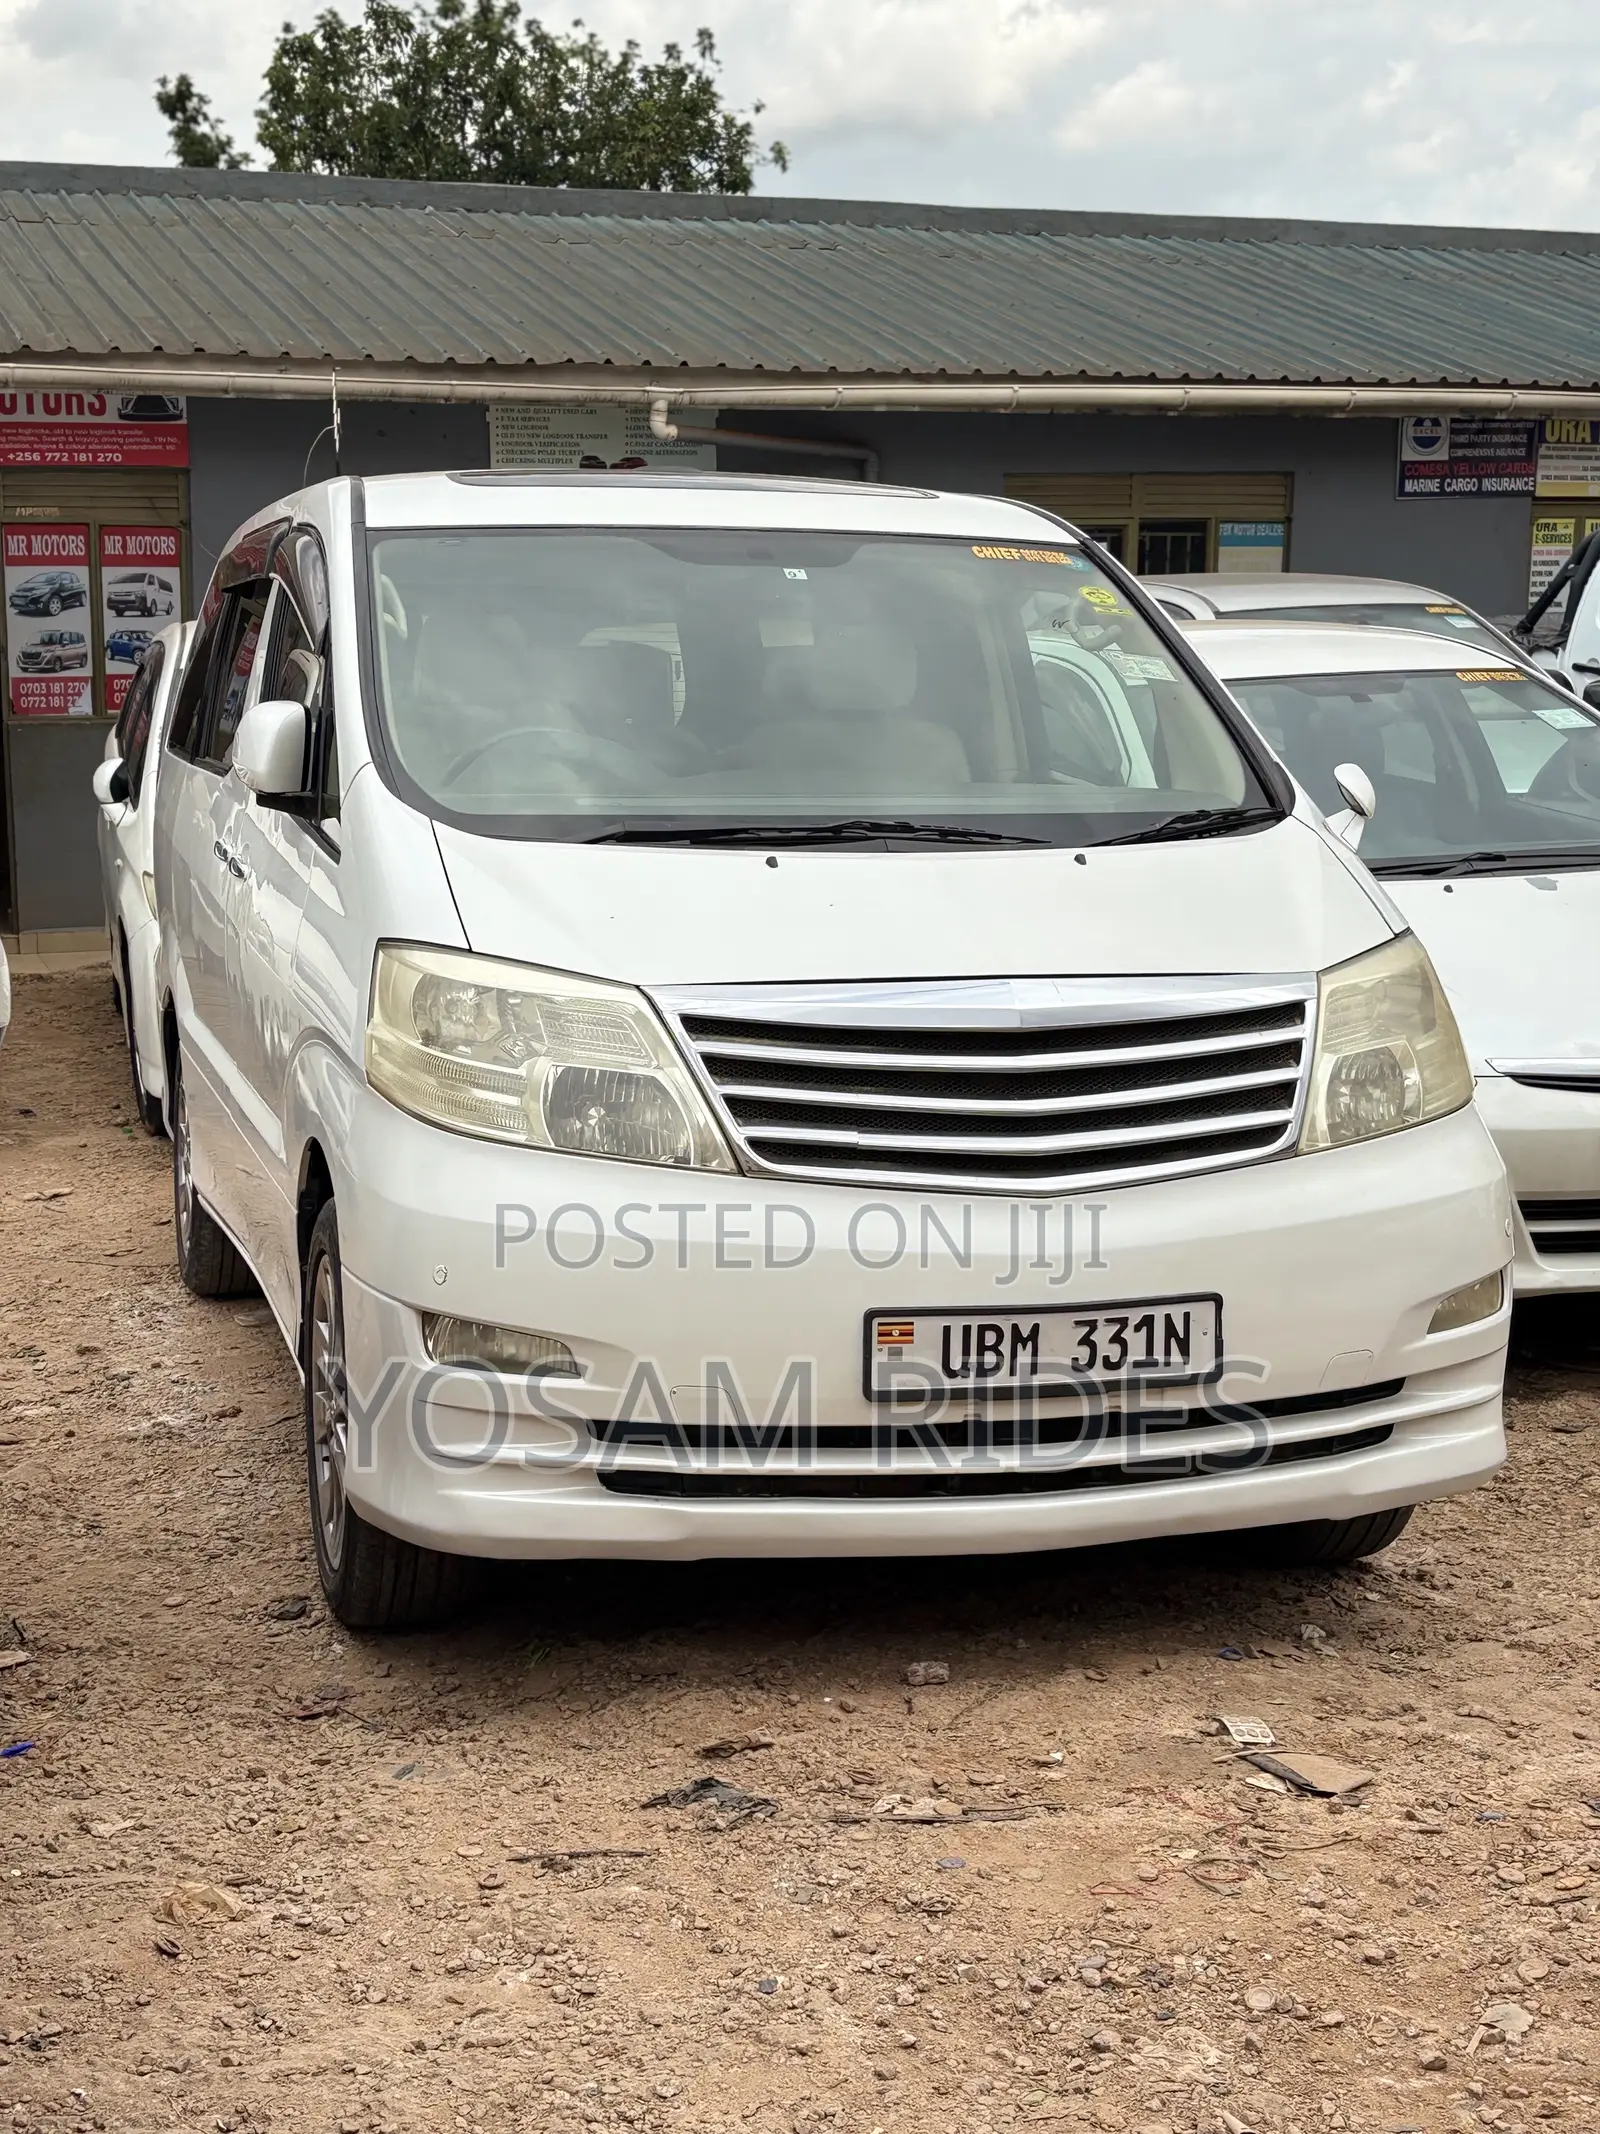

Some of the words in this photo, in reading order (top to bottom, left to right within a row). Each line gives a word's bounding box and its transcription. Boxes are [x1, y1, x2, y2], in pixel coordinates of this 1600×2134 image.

[1545, 420, 1591, 443] URA
[1450, 434, 1469, 443] THIRD
[1470, 434, 1490, 443] PARTY
[1491, 434, 1528, 443] INSURANCE
[7, 452, 41, 462] +256
[44, 452, 69, 462] 772
[72, 453, 93, 462] 181
[97, 453, 122, 462] 270
[1404, 464, 1450, 476] COMESA
[1453, 463, 1496, 475] YELLOW
[1499, 463, 1535, 475] CARDS
[1404, 479, 1441, 493] MARINE
[1444, 478, 1478, 492] CARGO
[1482, 477, 1535, 491] INSURANCE
[1536, 523, 1558, 532] URA
[1535, 533, 1573, 544] E-SERVICES
[7, 535, 28, 556] MR
[31, 535, 85, 556] MOTORS
[104, 535, 123, 555] MR
[126, 535, 176, 555] MOTORS
[971, 546, 1021, 561] CHIEF
[1456, 671, 1492, 682] CHIEF
[20, 682, 47, 694] 0703
[50, 682, 65, 694] 181
[20, 696, 47, 708] 0772
[50, 696, 64, 708] 181
[940, 1322, 1041, 1379] UBM
[1070, 1310, 1191, 1373] 331N
